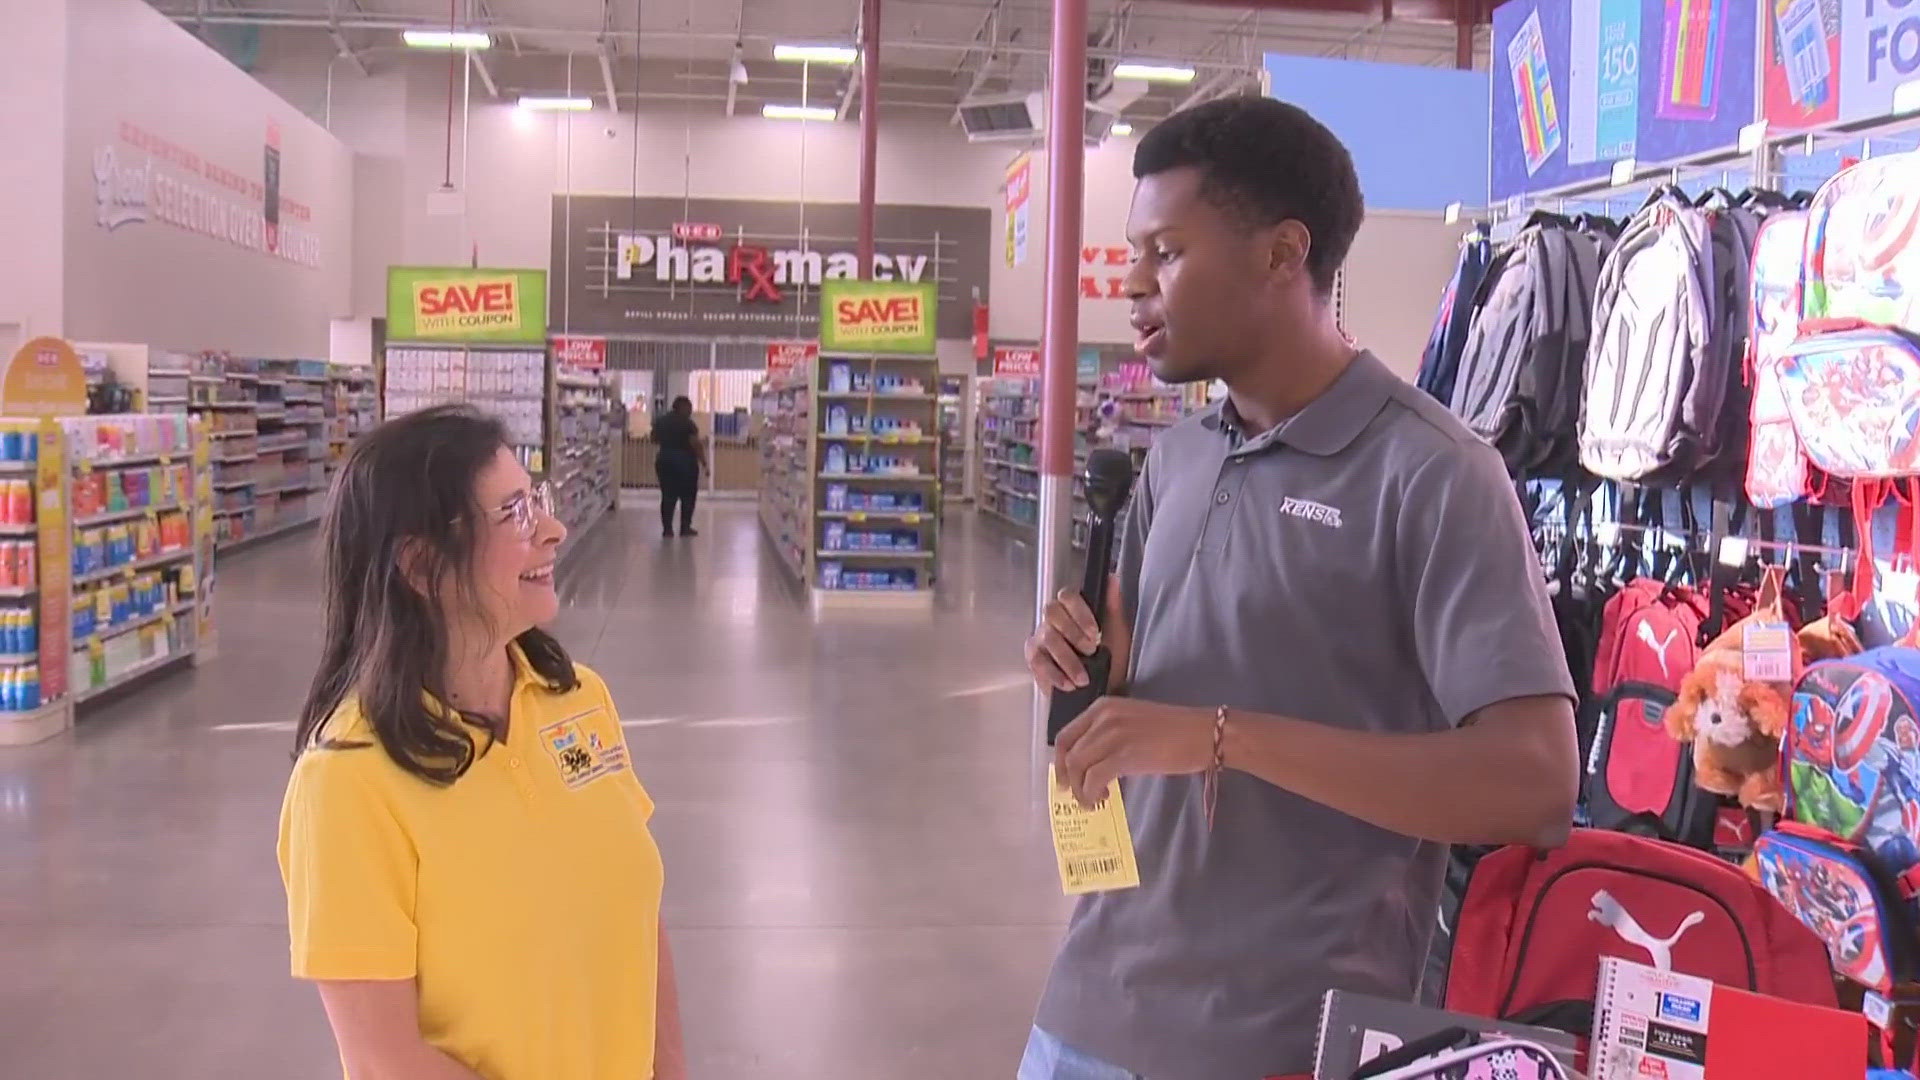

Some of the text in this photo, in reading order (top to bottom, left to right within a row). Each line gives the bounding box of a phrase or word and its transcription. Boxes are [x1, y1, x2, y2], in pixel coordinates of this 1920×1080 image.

[1603, 42, 1637, 84] 150
[154, 171, 227, 241] SELECTION
[419, 282, 513, 316] SAVE!
[422, 313, 513, 330] WITH COUPON
[838, 297, 919, 325] SAVE!
[840, 324, 919, 336] WITH COUPON
[998, 361, 1040, 373] PRICES
[1005, 351, 1033, 362] LOW
